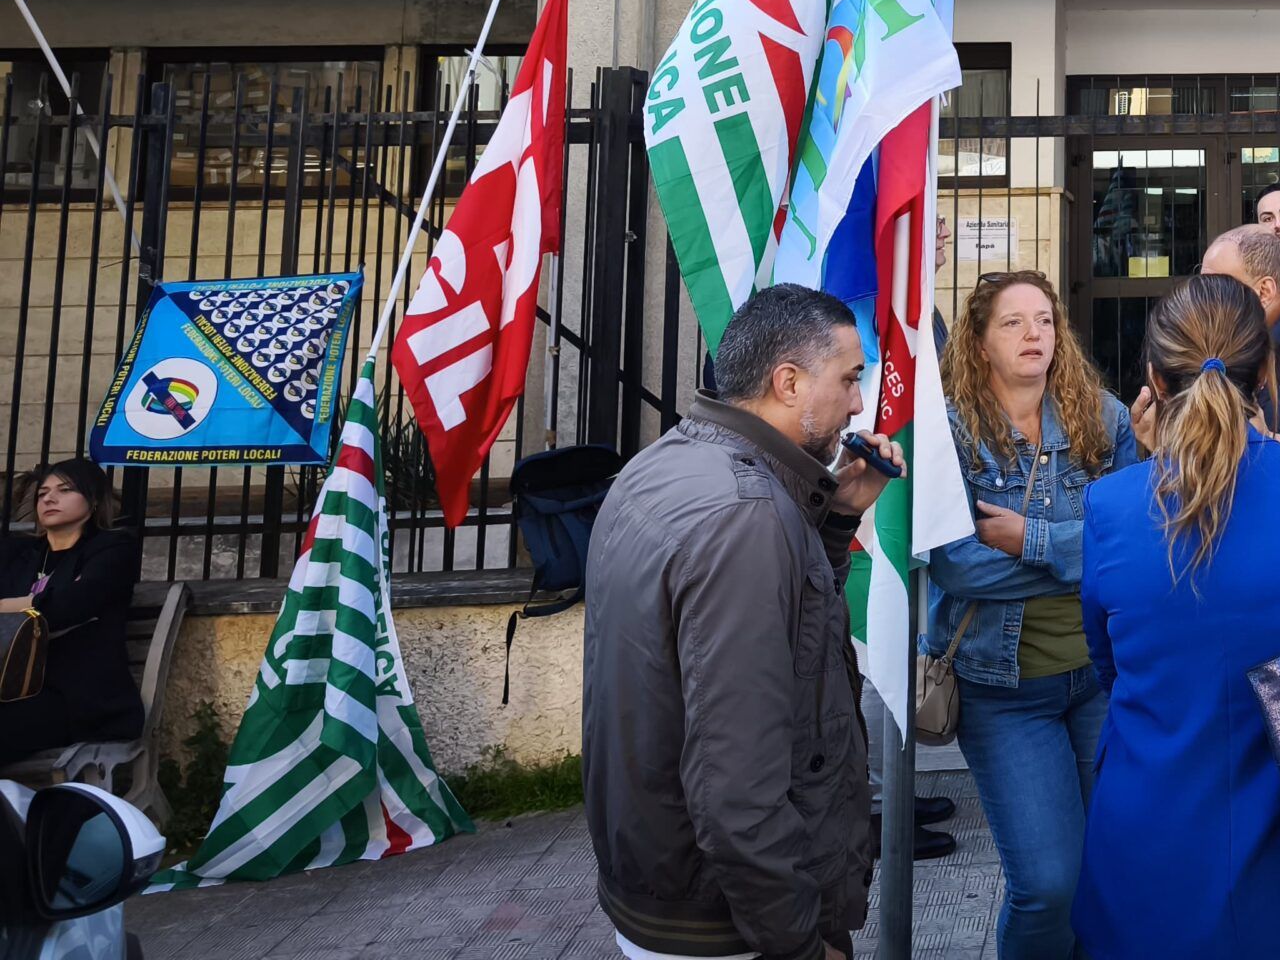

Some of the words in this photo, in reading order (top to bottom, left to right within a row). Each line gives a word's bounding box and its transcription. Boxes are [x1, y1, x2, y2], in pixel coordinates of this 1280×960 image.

[193, 313, 217, 338] LOCALI
[211, 333, 236, 358] POTERI
[110, 365, 130, 395] POTERI
[231, 353, 278, 401] FEDERAZIONE
[96, 397, 116, 427] LOCALI
[126, 449, 199, 461] FEDERAZIONE
[201, 449, 240, 460] POTERI
[243, 448, 282, 460] LOCALI
